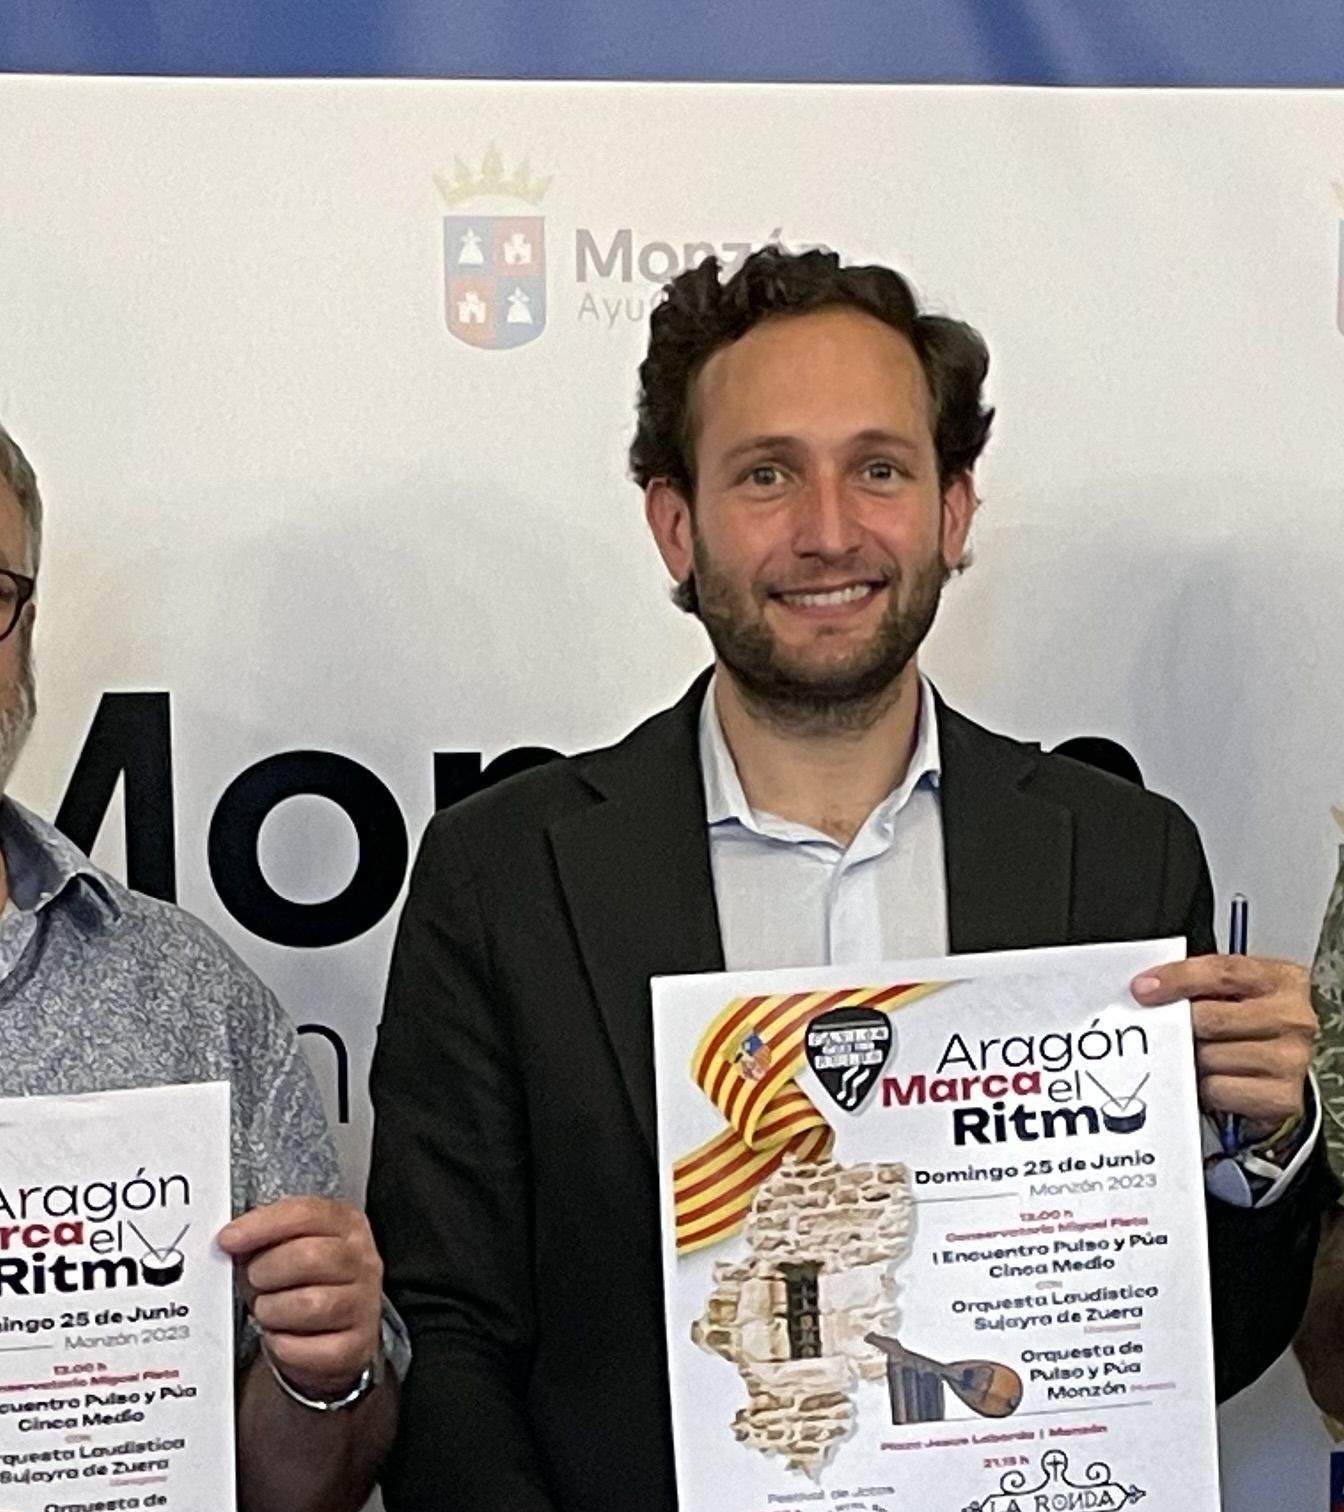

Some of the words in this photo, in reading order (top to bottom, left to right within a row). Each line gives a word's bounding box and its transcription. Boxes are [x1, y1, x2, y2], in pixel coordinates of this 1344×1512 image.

[936, 1018, 1148, 1073] Aragón
[882, 1071, 1041, 1107] Marca
[1048, 1069, 1082, 1102] el
[915, 1165, 1018, 1186] Domingo
[1023, 1160, 1053, 1176] 25
[1058, 1157, 1086, 1172] de
[1090, 1150, 1155, 1170] Junio
[1029, 1180, 1103, 1197] Monzón
[1108, 1173, 1157, 1190] 2023
[89, 1220, 123, 1254] el
[943, 1244, 1050, 1263] Encuentro
[1053, 1238, 1110, 1254] Pulso
[1113, 1238, 1125, 1252] y
[989, 1262, 1048, 1278] Cinca
[1052, 1256, 1115, 1273] Medio
[60, 1311, 90, 1328] 25
[95, 1309, 123, 1326] de
[126, 1302, 189, 1323] Junio
[951, 1296, 1047, 1314] Orquesta
[1057, 1310, 1081, 1323] de
[142, 1325, 190, 1344] 2023
[1021, 1344, 1115, 1364] Orquesta
[1119, 1342, 1143, 1355] de
[1030, 1365, 1084, 1382] Pulso
[1088, 1365, 1098, 1378] y
[144, 1390, 156, 1405] y
[1047, 1381, 1126, 1400] Monzón
[18, 1416, 78, 1432] Cinca
[82, 1409, 145, 1427] Medio
[82, 1464, 108, 1478] de
[143, 1493, 167, 1508] de
